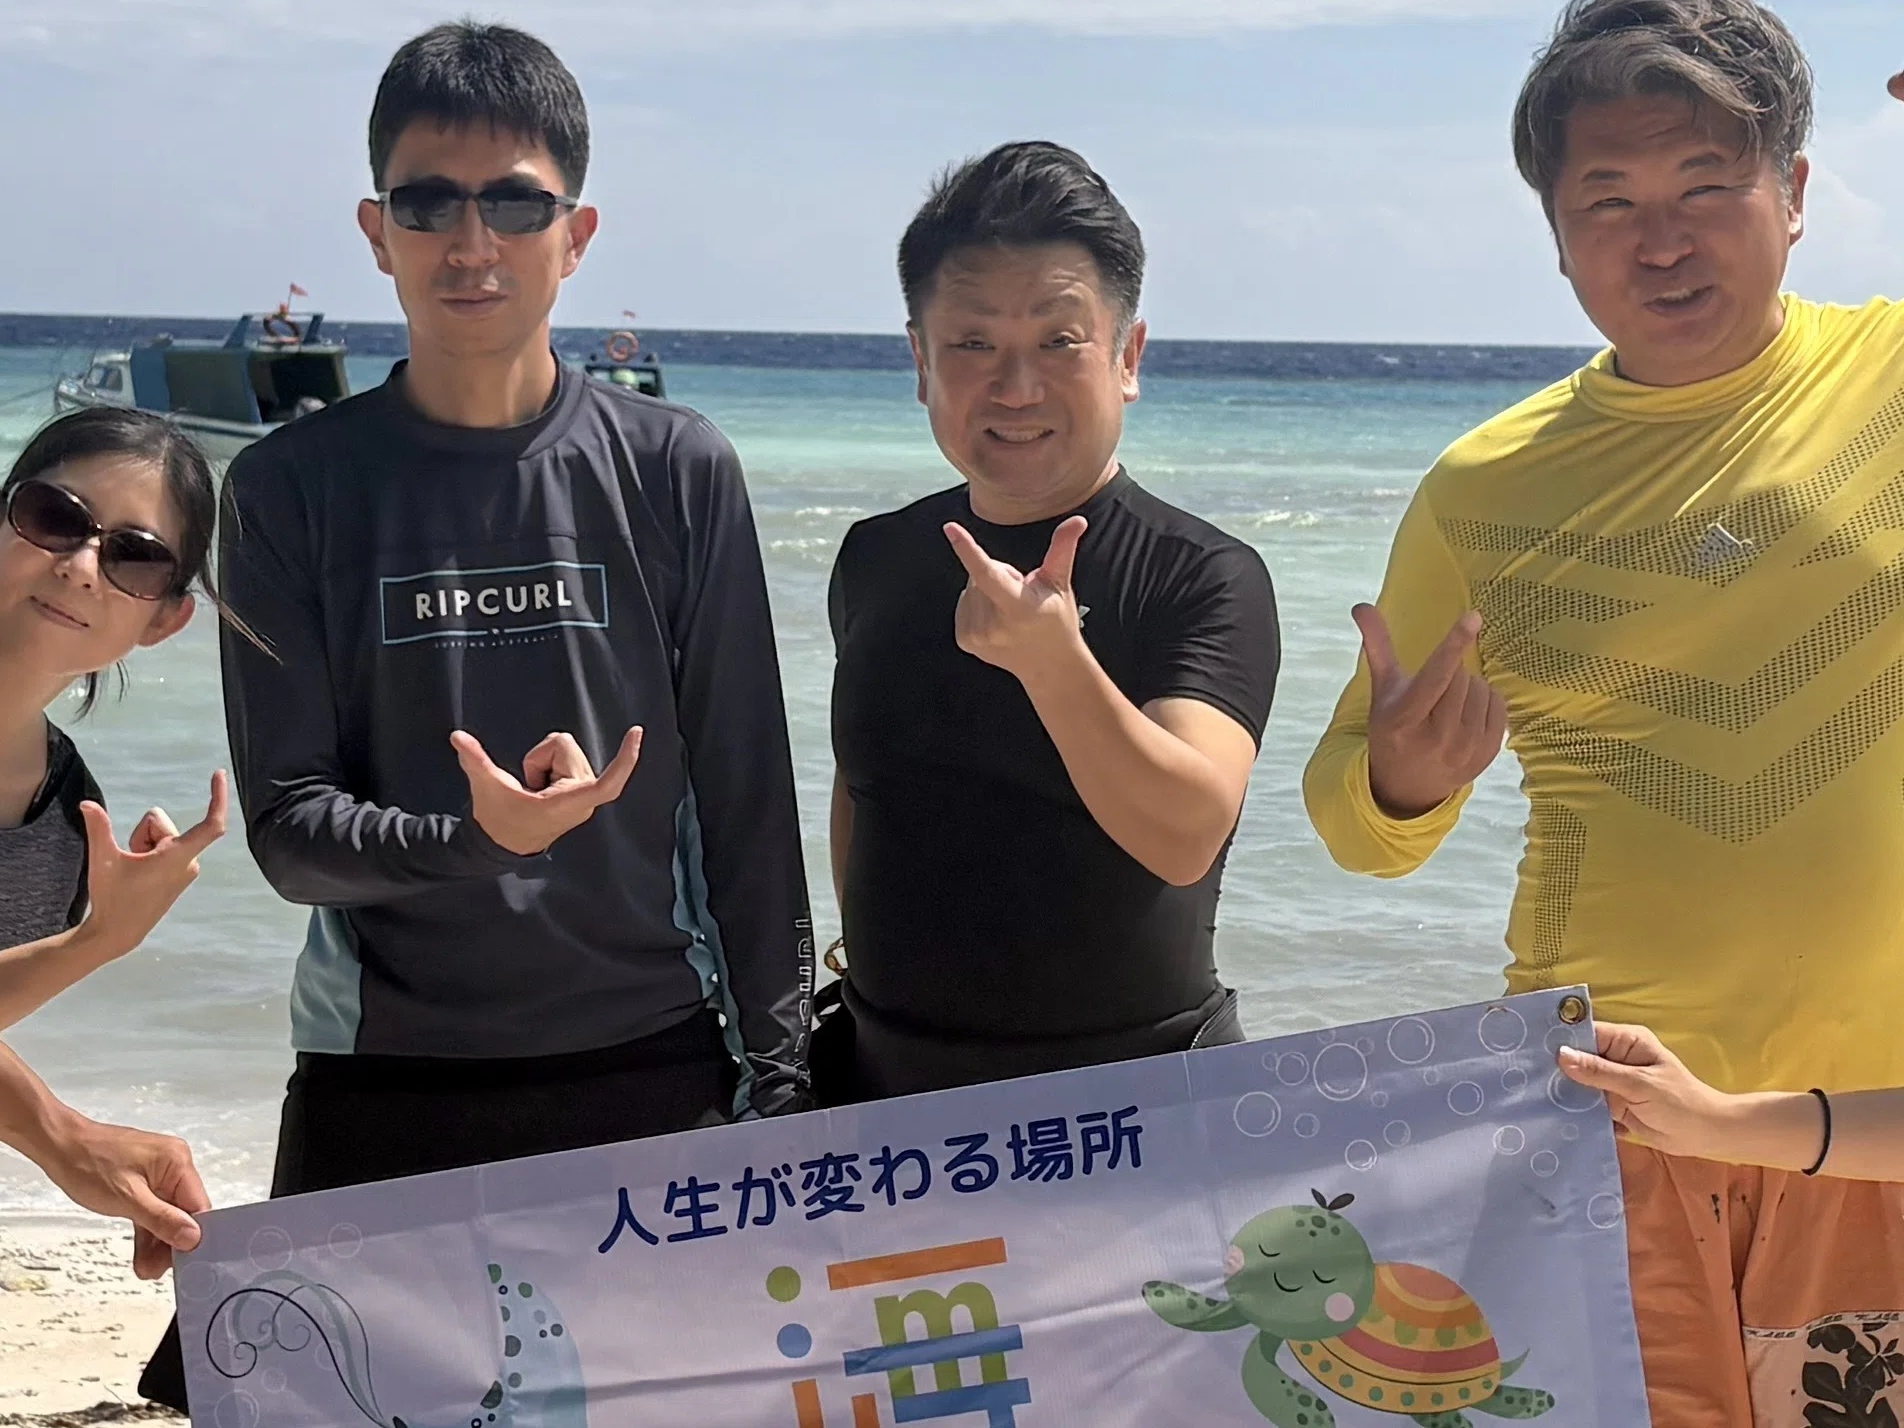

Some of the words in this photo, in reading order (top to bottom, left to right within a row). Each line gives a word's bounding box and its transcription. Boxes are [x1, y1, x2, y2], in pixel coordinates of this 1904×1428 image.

[415, 579, 573, 620] RIPCURL
[597, 1105, 1143, 1254] 人生が変わる場所
